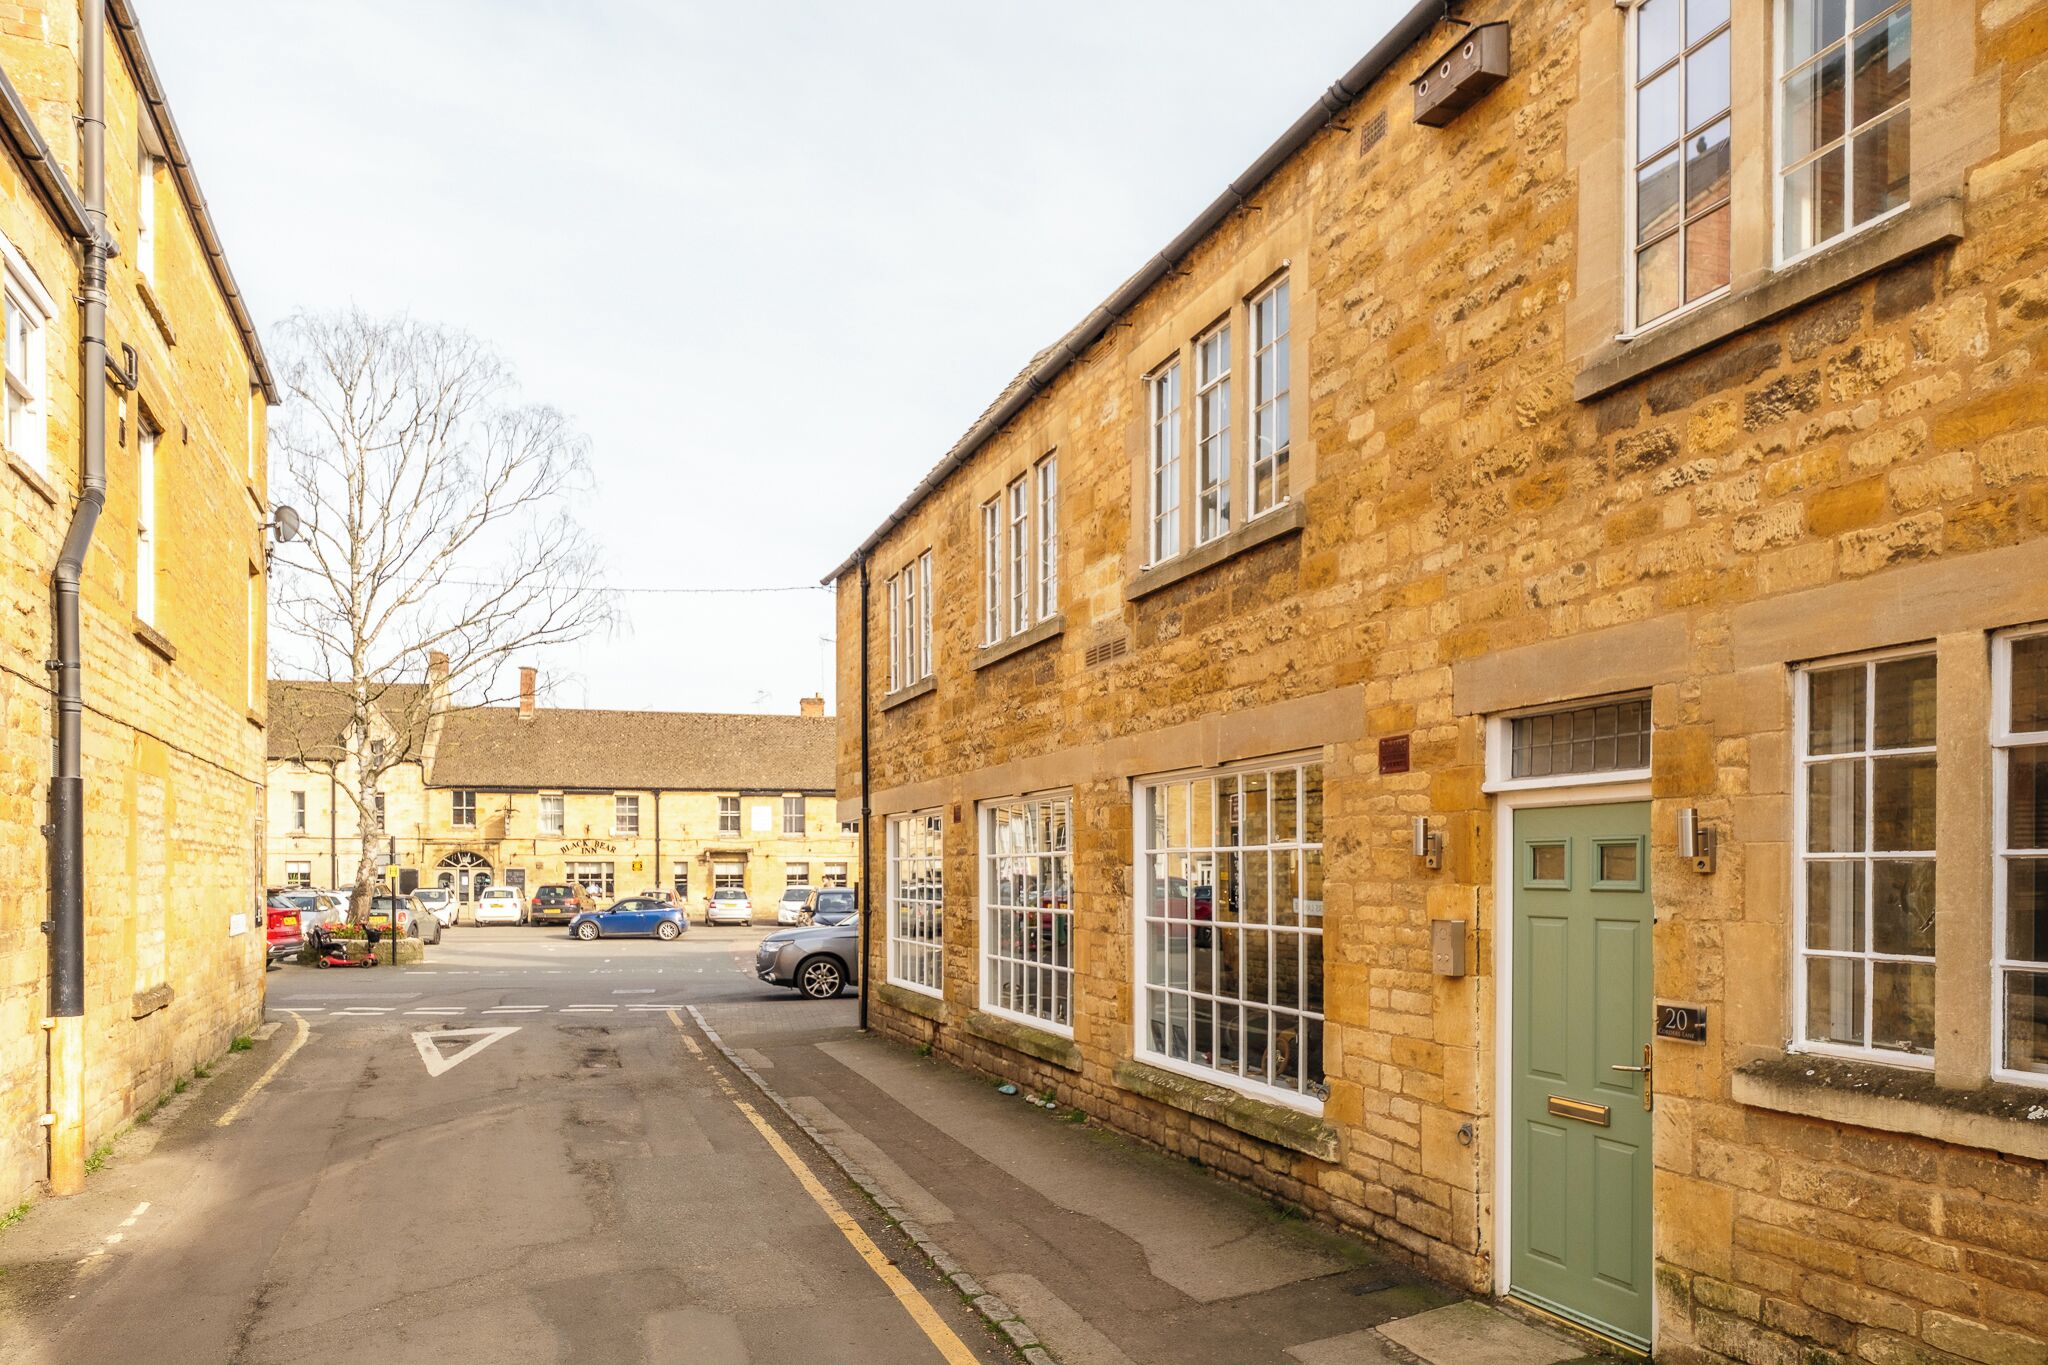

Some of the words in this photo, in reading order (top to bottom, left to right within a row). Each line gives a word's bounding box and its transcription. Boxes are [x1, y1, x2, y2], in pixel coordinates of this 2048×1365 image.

[560, 840, 588, 854] BLACK
[594, 840, 617, 854] BEAR
[1665, 1008, 1687, 1031] 20
